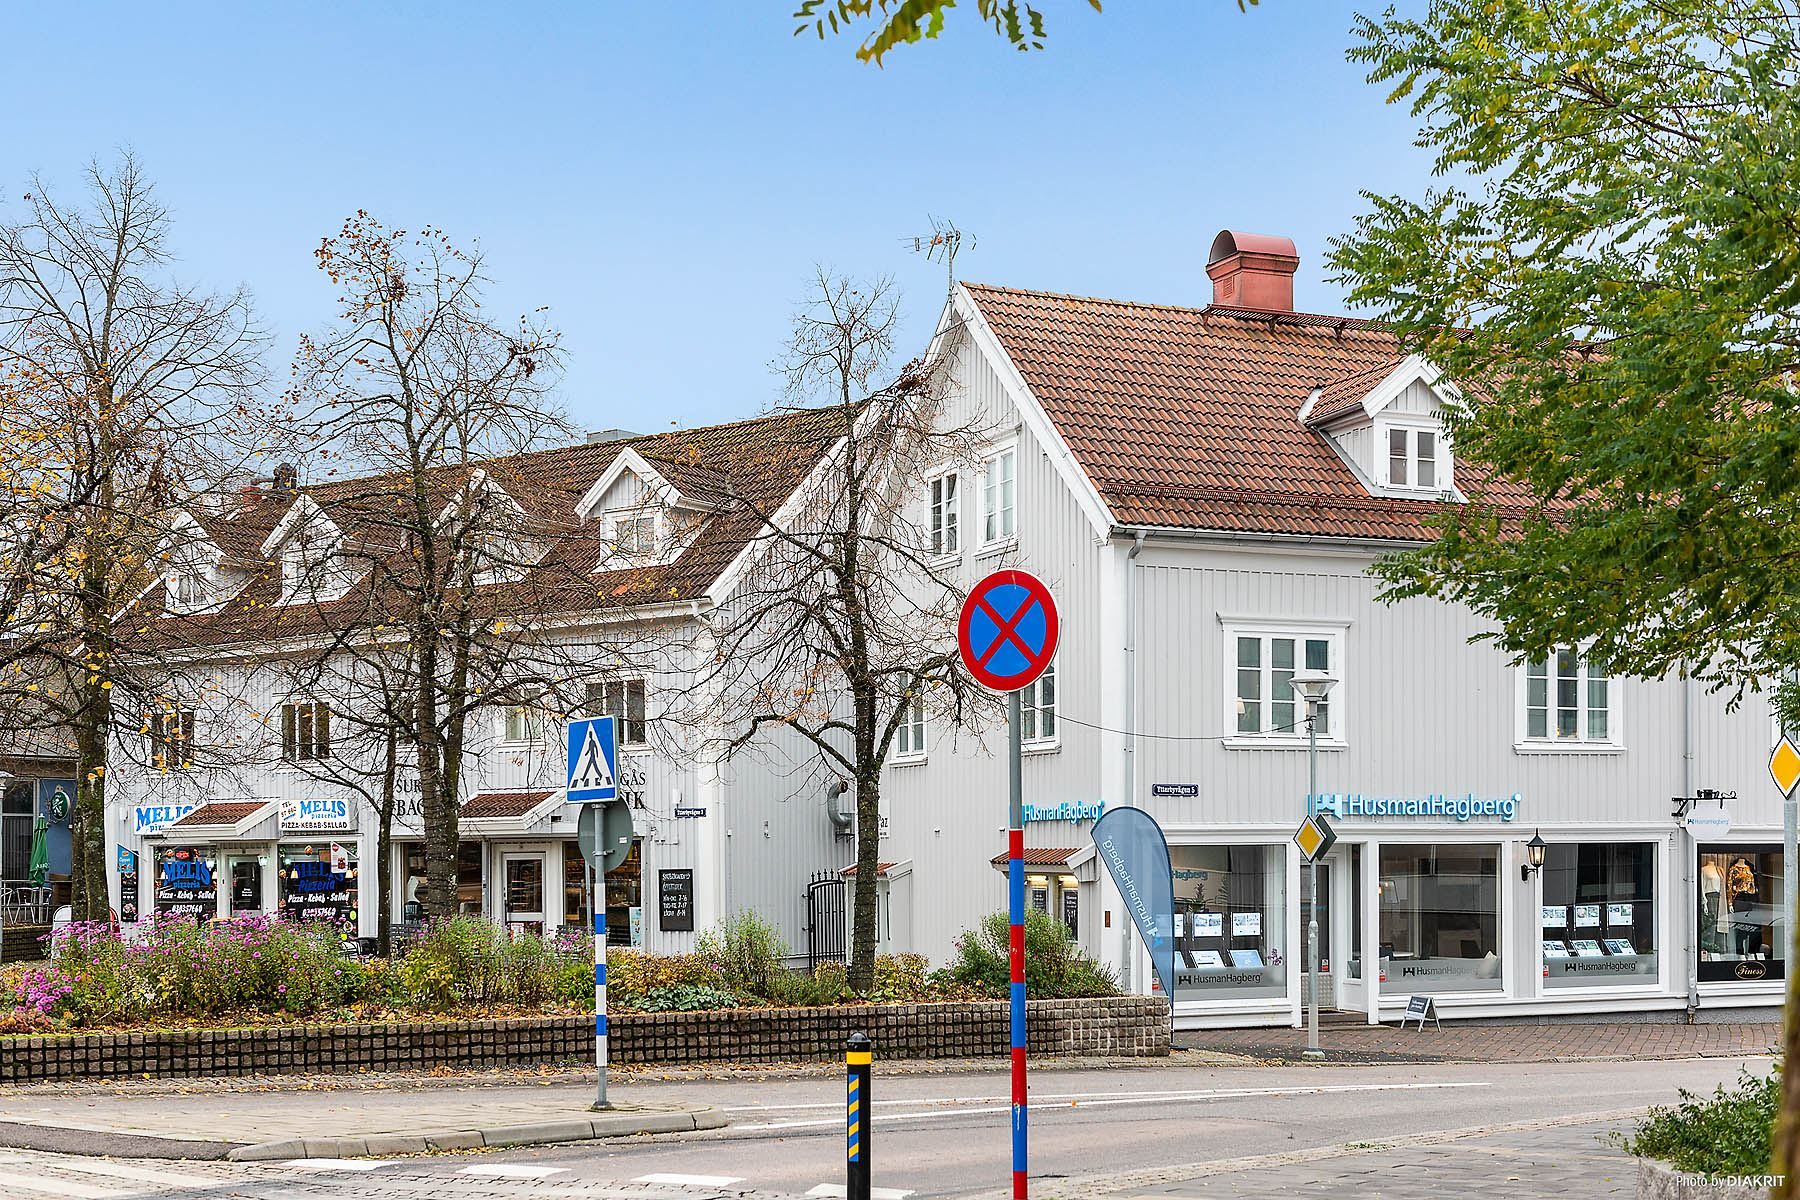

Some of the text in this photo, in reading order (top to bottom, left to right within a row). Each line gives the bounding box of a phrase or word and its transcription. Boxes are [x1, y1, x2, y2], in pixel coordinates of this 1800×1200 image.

[300, 800, 346, 819] MELIS
[1024, 801, 1099, 824] HusmanHagberg
[1348, 793, 1515, 821] HusmanHagberg
[1578, 961, 1636, 972] HusmanHagberg
[1194, 973, 1261, 984] HusmanHagberg
